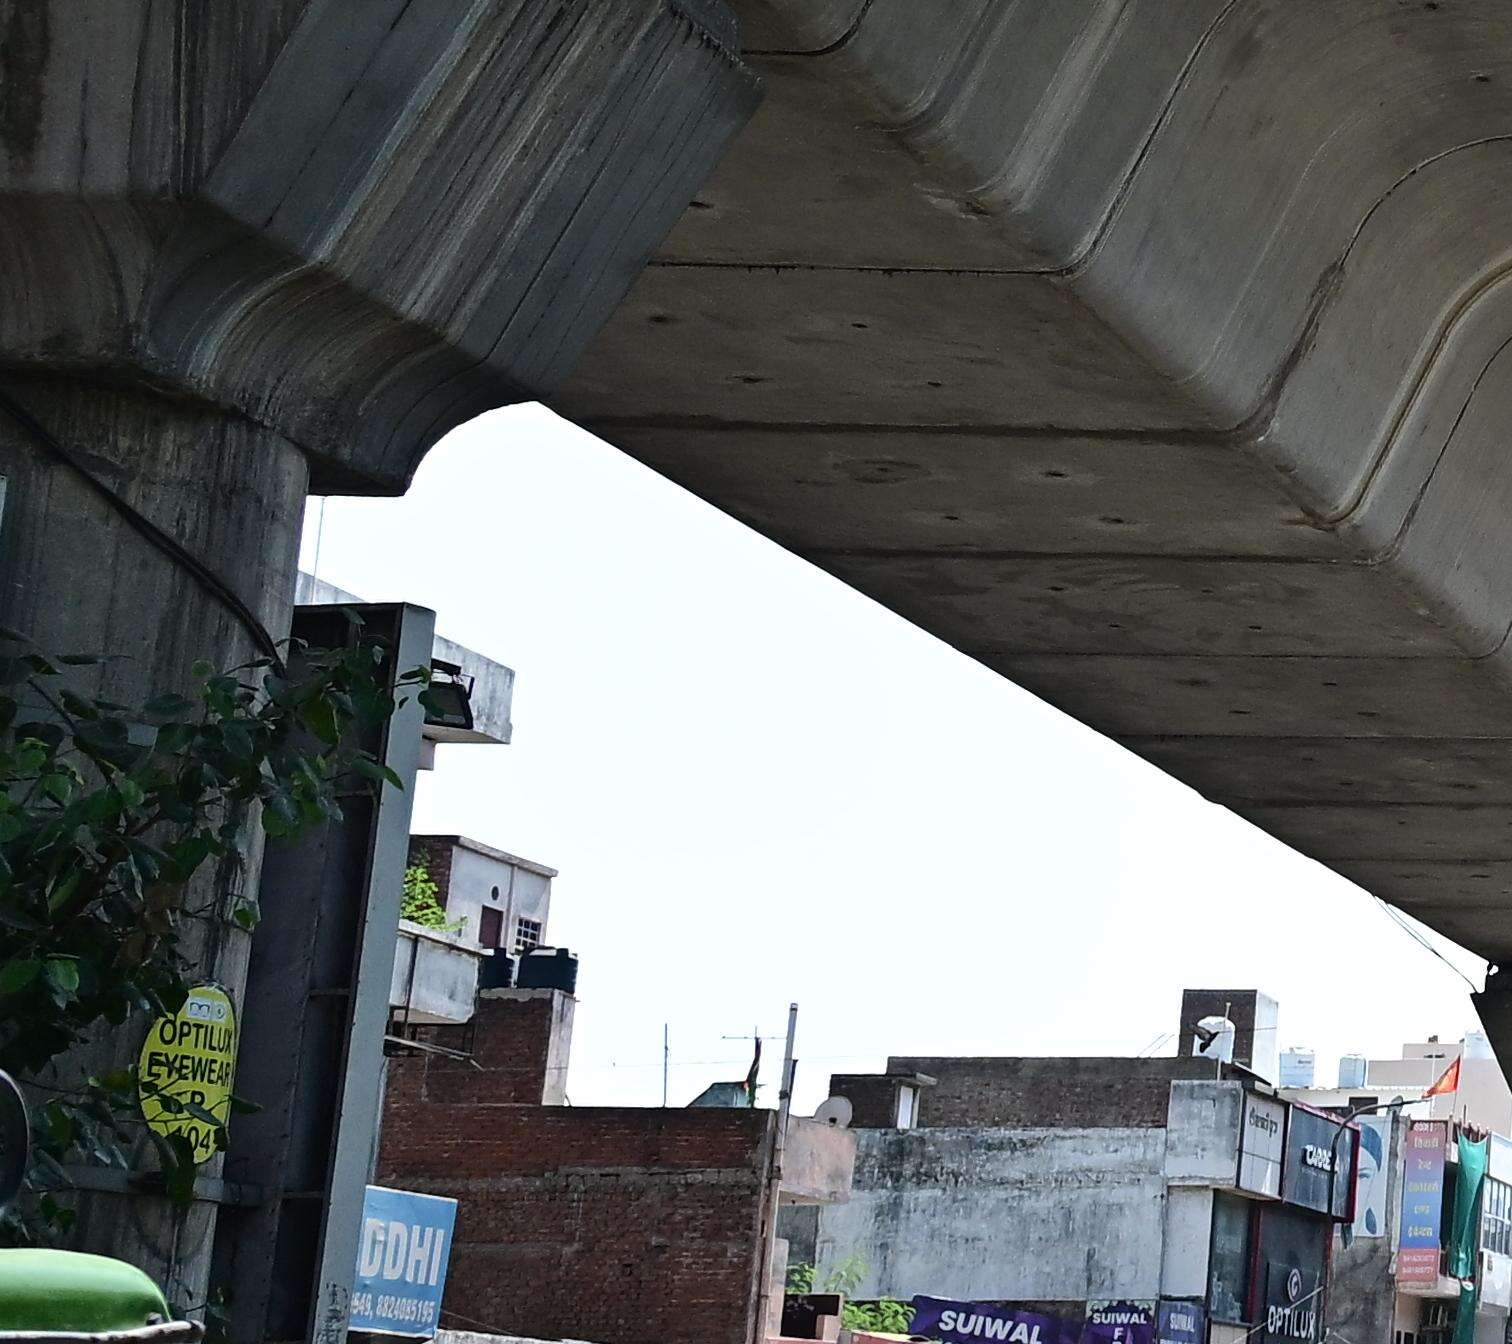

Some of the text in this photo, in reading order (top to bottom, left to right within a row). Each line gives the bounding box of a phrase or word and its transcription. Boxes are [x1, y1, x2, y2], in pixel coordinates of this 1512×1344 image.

[159, 1018, 234, 1055] OPTILUX
[146, 1051, 230, 1086] EYEWEAR
[1092, 1313, 1147, 1324] SUIWAL
[1267, 1305, 1316, 1340] OPTILUX
